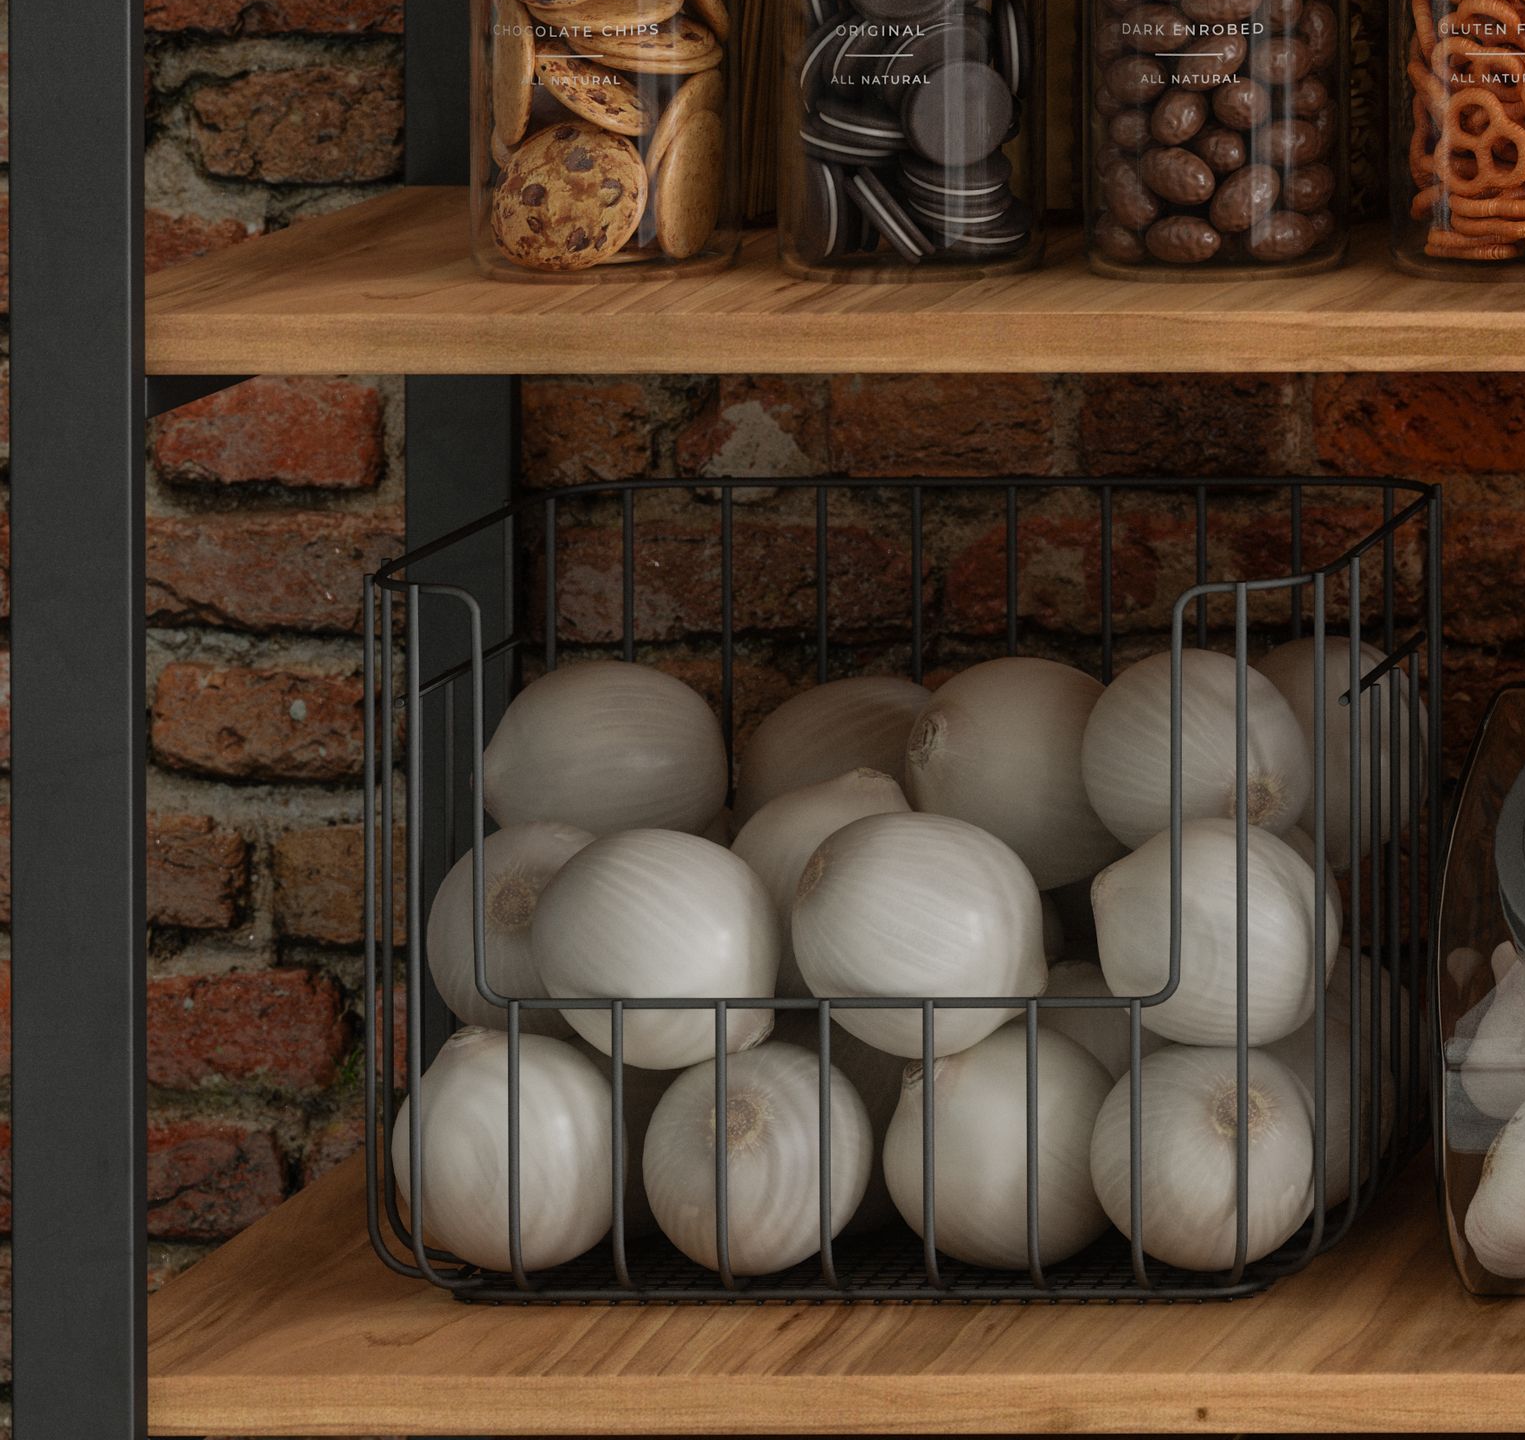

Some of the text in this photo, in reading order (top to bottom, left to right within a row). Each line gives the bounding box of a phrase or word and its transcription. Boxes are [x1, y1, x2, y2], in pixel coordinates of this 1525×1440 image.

[493, 23, 659, 39] CHOCOLATE CHIPS
[835, 24, 926, 38] ORIGINAL
[1121, 22, 1264, 36] DARK ENROBED
[1440, 22, 1507, 36] GLUTEN
[831, 74, 931, 85] ALL NATURAL
[1140, 73, 1241, 84] ALL NATURAL
